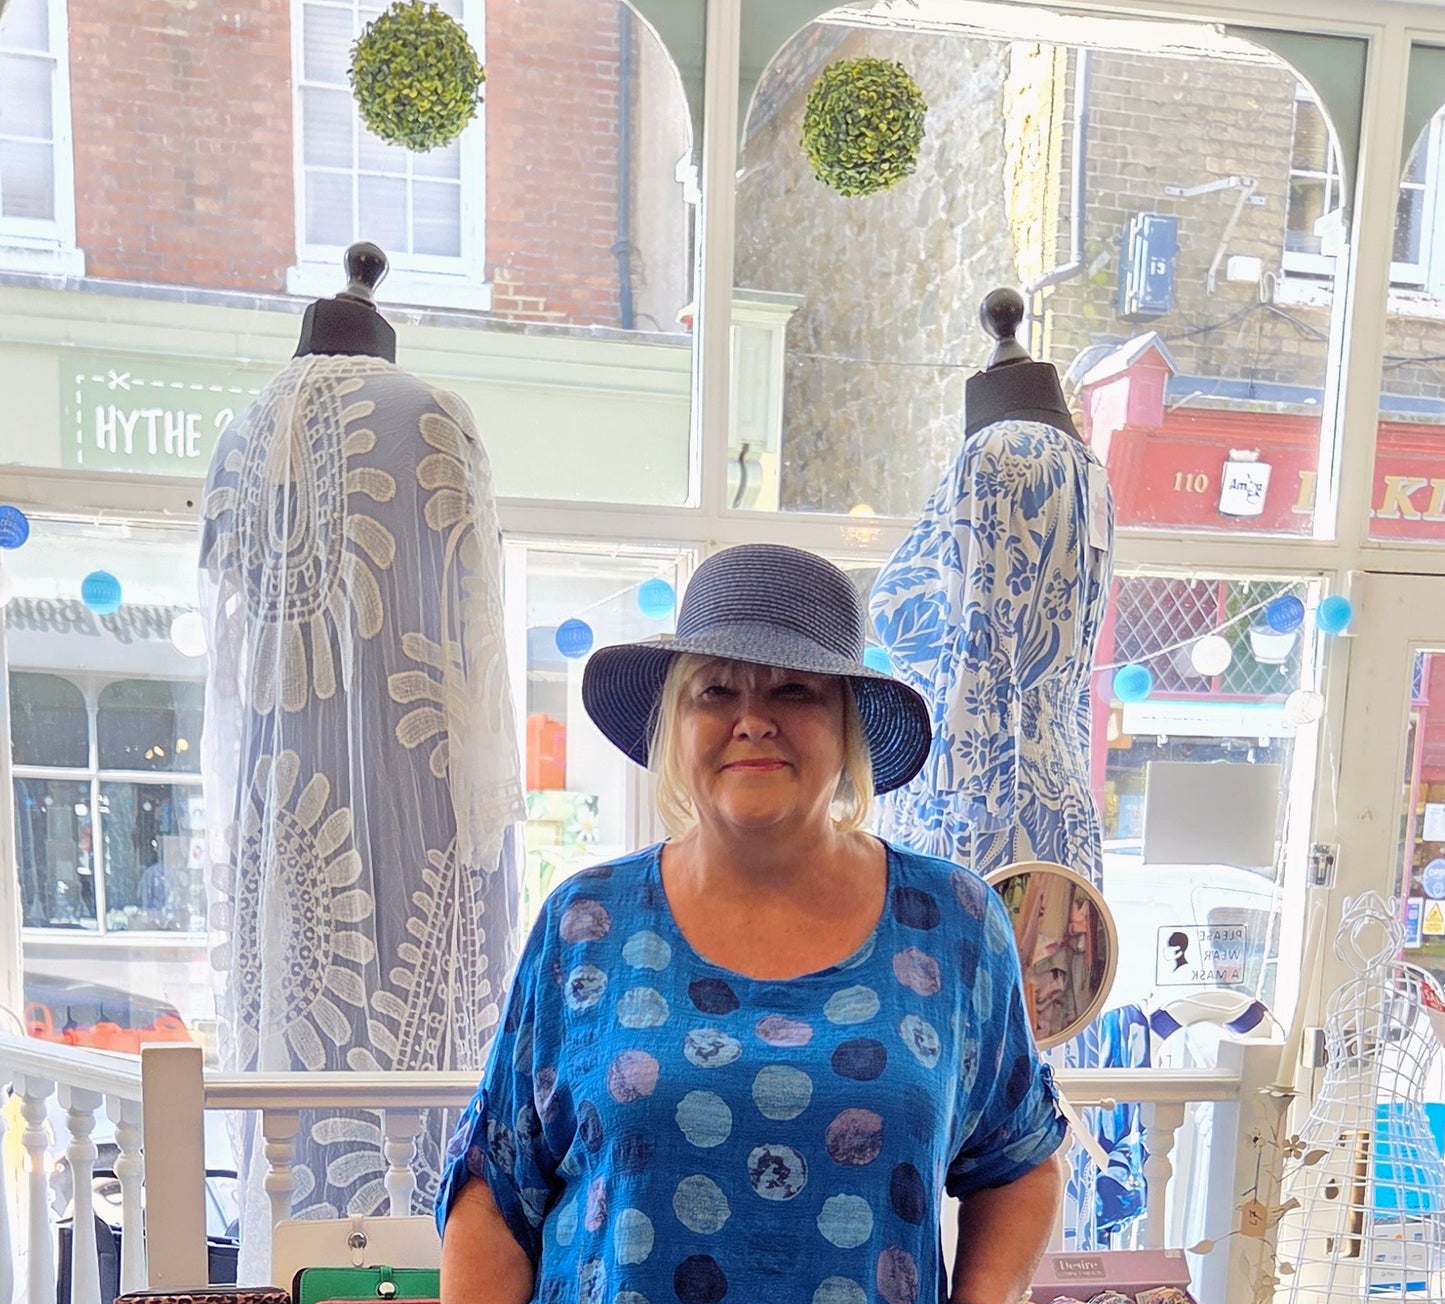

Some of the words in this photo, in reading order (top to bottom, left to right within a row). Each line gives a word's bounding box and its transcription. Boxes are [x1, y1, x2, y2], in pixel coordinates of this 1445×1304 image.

[95, 404, 202, 458] HYTHE
[1173, 471, 1209, 494] 110
[1059, 1259, 1098, 1271] Desire
